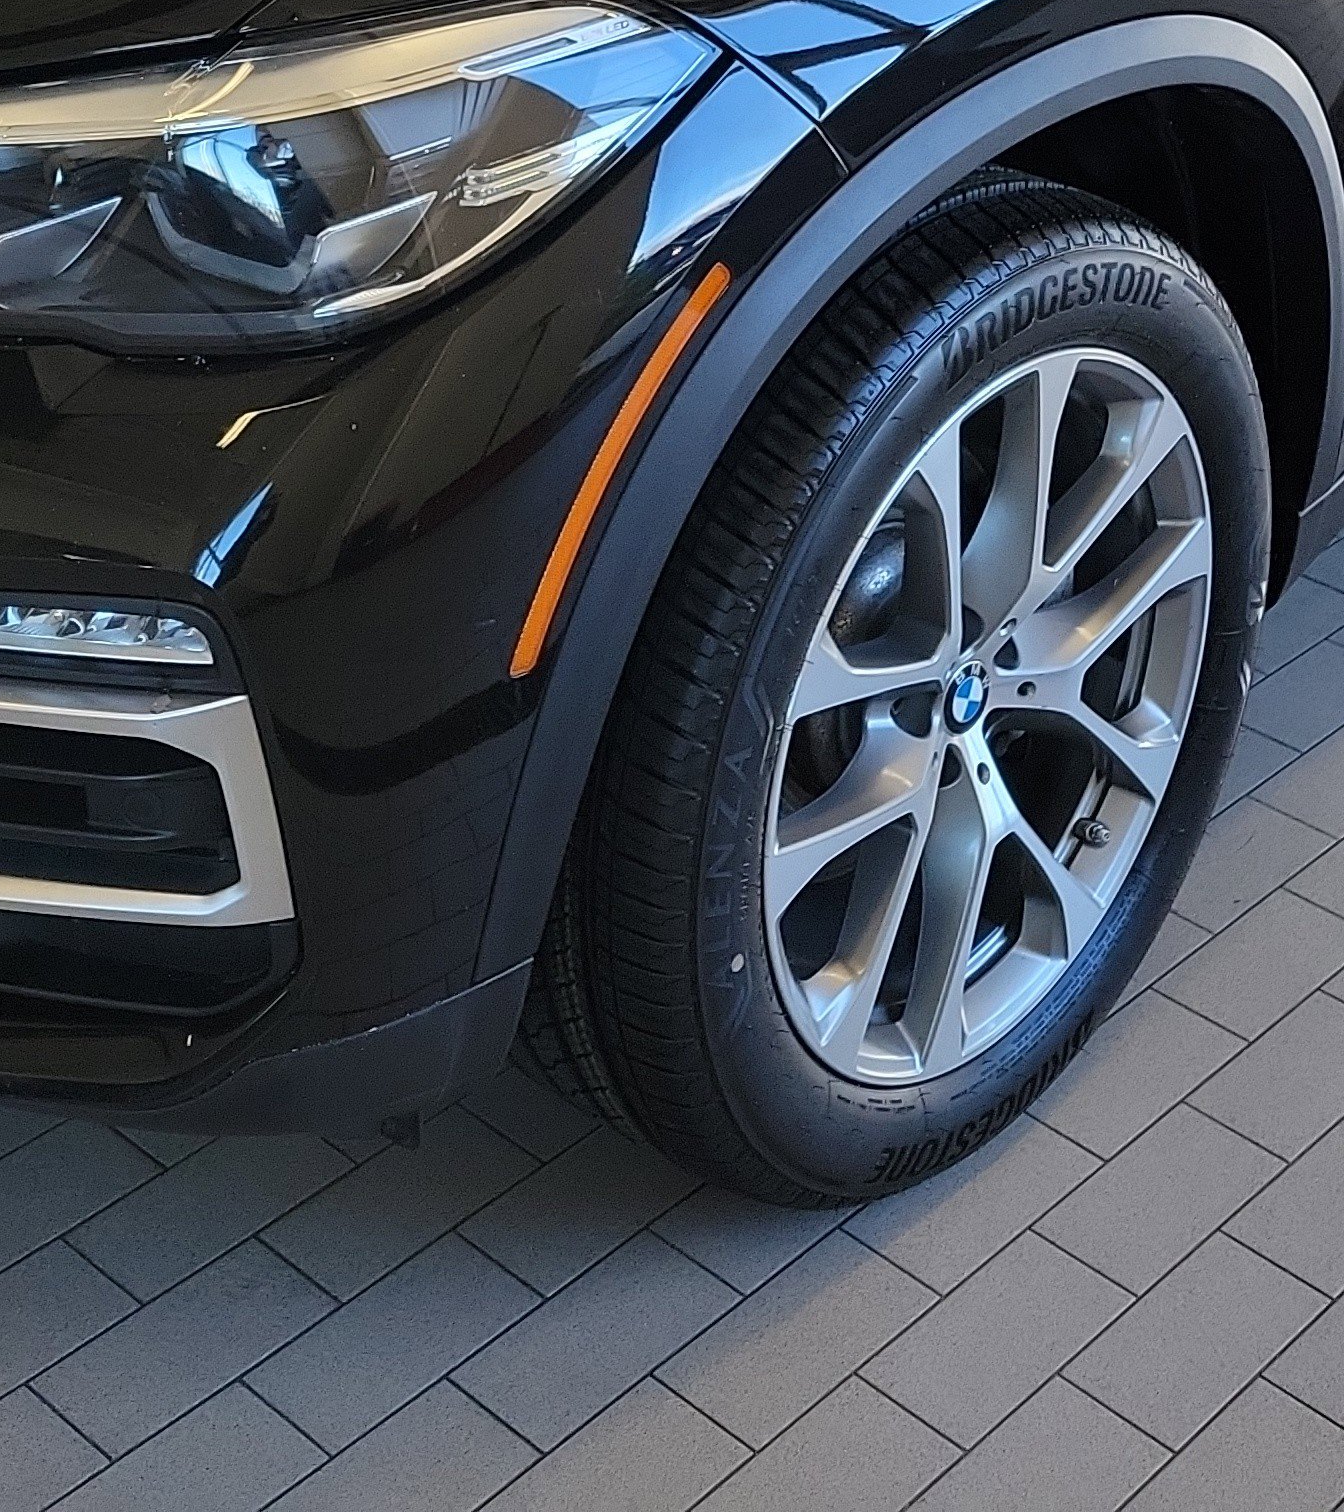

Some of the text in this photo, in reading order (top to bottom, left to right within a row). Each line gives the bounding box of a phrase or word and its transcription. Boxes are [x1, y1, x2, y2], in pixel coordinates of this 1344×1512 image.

[941, 261, 1172, 387] BRIDGESTONE
[954, 662, 992, 690] BMW
[699, 745, 754, 991] ALENZA
